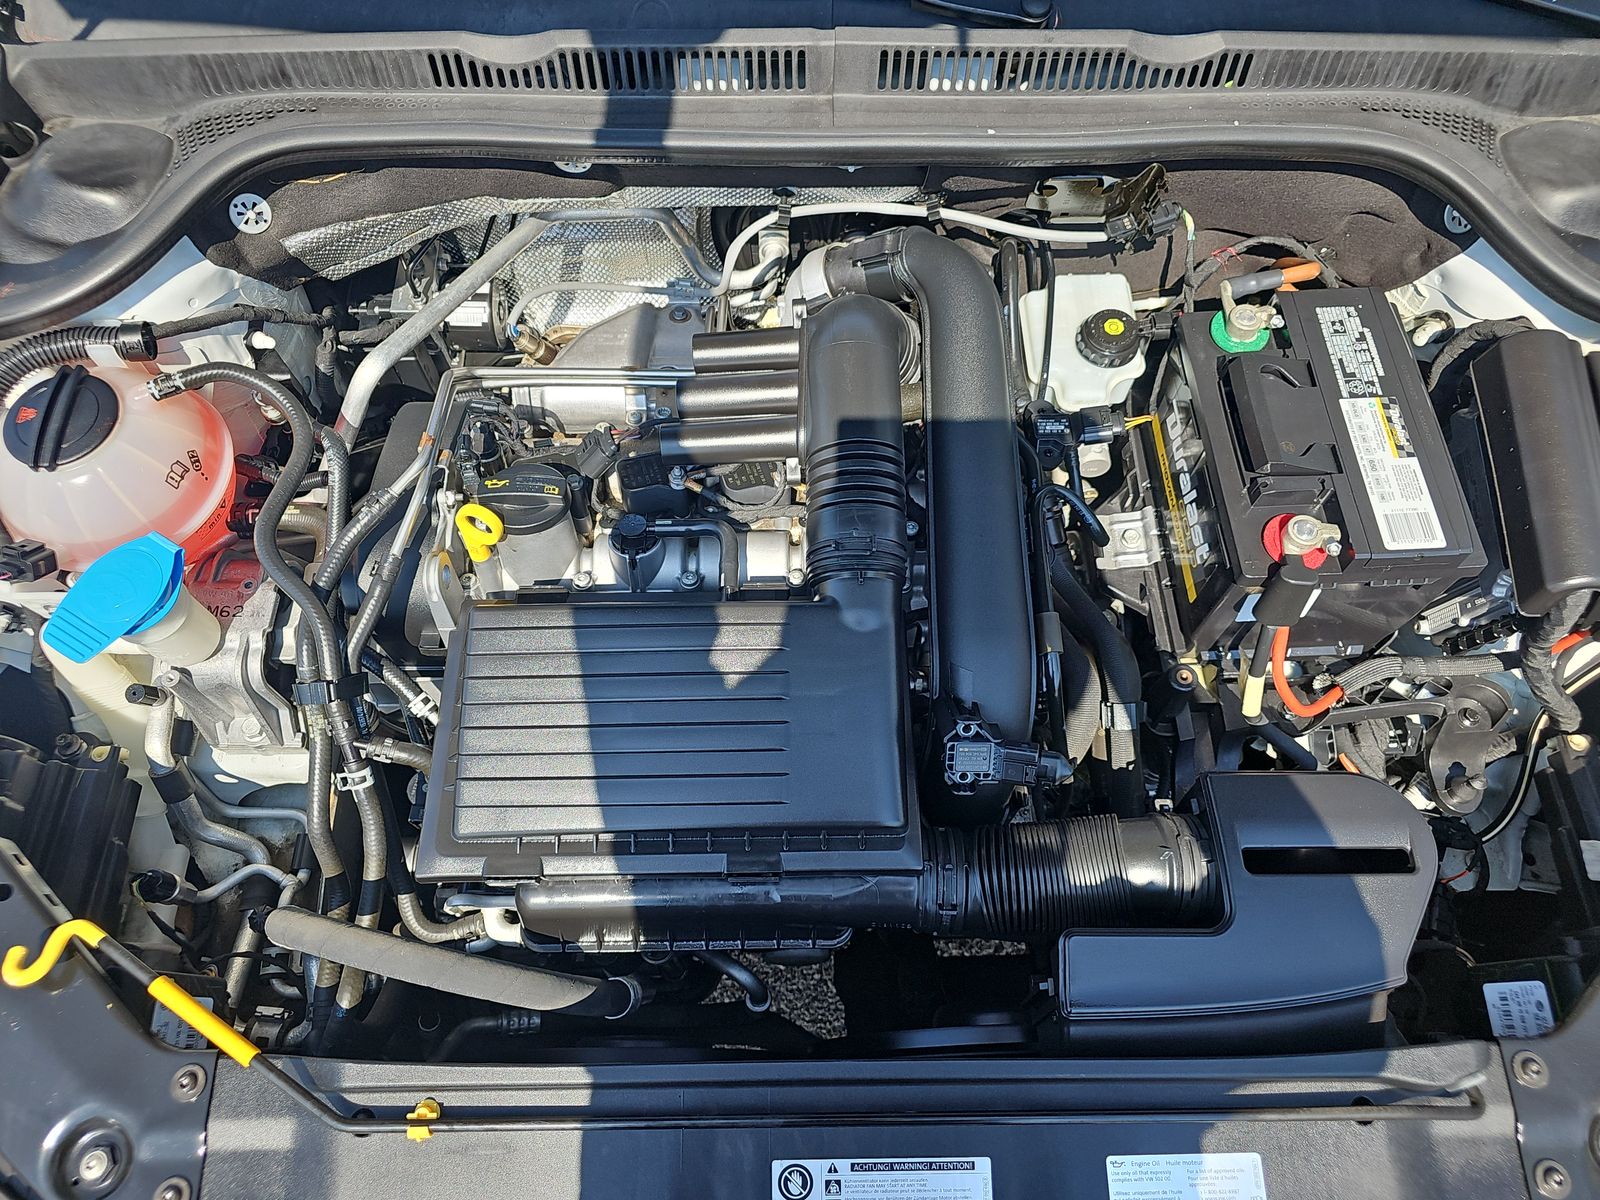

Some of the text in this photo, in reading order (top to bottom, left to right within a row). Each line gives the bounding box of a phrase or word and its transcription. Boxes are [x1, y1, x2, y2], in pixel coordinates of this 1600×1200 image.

[1388, 406, 1411, 446] Duralast
[188, 451, 202, 471] G12
[1367, 459, 1378, 471] 650
[1161, 453, 1176, 509] PROVEN
[1165, 399, 1209, 565] Duralast
[208, 513, 221, 530] min
[853, 1162, 973, 1170] ACHTUNG! WARNING! ATTENTION!
